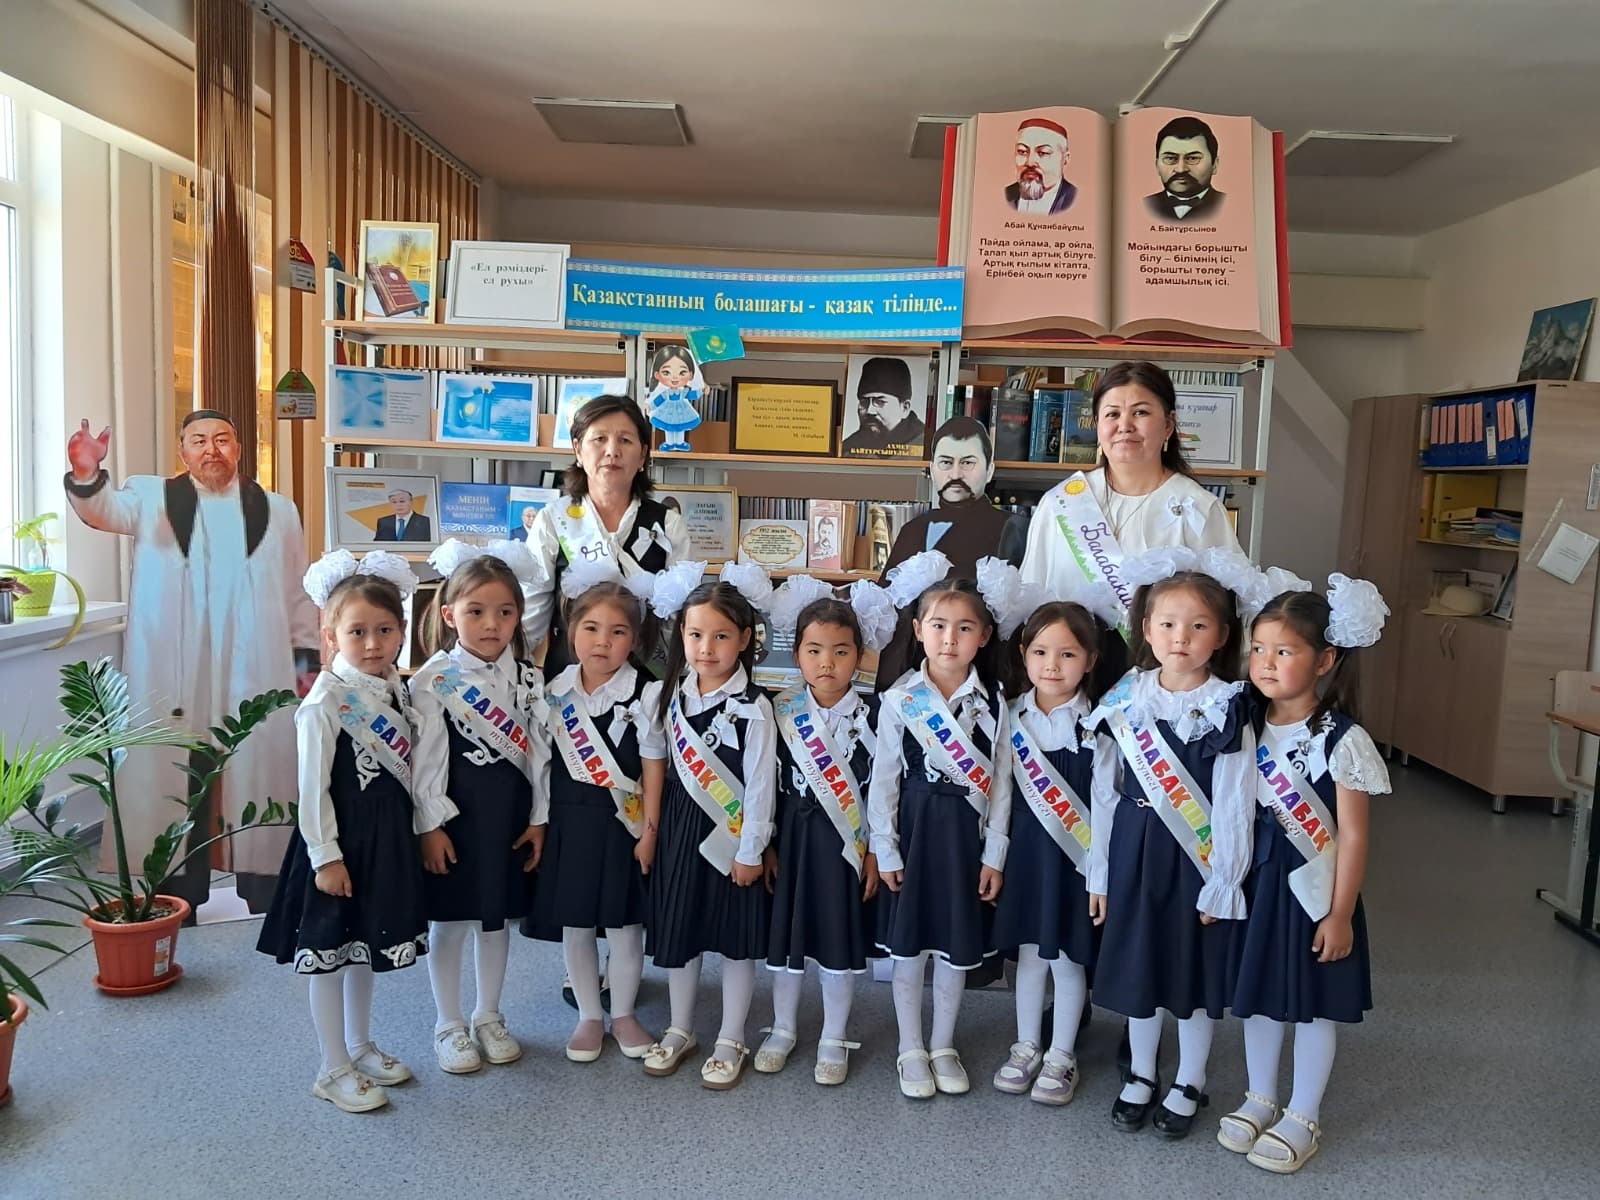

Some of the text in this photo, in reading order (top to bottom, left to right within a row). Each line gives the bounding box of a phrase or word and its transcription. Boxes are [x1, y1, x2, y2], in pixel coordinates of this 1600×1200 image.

[1004, 221, 1085, 231] Абай Құнанбайұлы
[979, 238, 1010, 247] Пайда
[1012, 239, 1051, 248] ойлама,
[1068, 241, 1095, 250] ойла,
[1127, 242, 1248, 253] Мойындағы борышты
[978, 248, 1096, 260] Талап қыл артық білуге,
[1139, 254, 1162, 263] білу
[1173, 254, 1218, 264] білімнің
[1219, 254, 1236, 264] ісі,
[470, 262, 490, 272] «Ел
[983, 259, 1015, 268] Артық
[1053, 261, 1091, 270] кітапта,
[986, 269, 1025, 279] Ерінбей
[1055, 272, 1088, 280] көруге
[1139, 265, 1193, 274] борышты
[1195, 267, 1226, 276] төлеу
[500, 276, 534, 287] рухы»
[1145, 277, 1213, 286] адамшылық
[572, 283, 705, 313] Қазақстанның
[714, 292, 804, 314] болашағы
[825, 300, 874, 315] қазақ
[883, 293, 958, 315] тілінде...
[926, 713, 992, 798] БАЛАБА
[1256, 744, 1334, 854] БАЛАБАҚ
